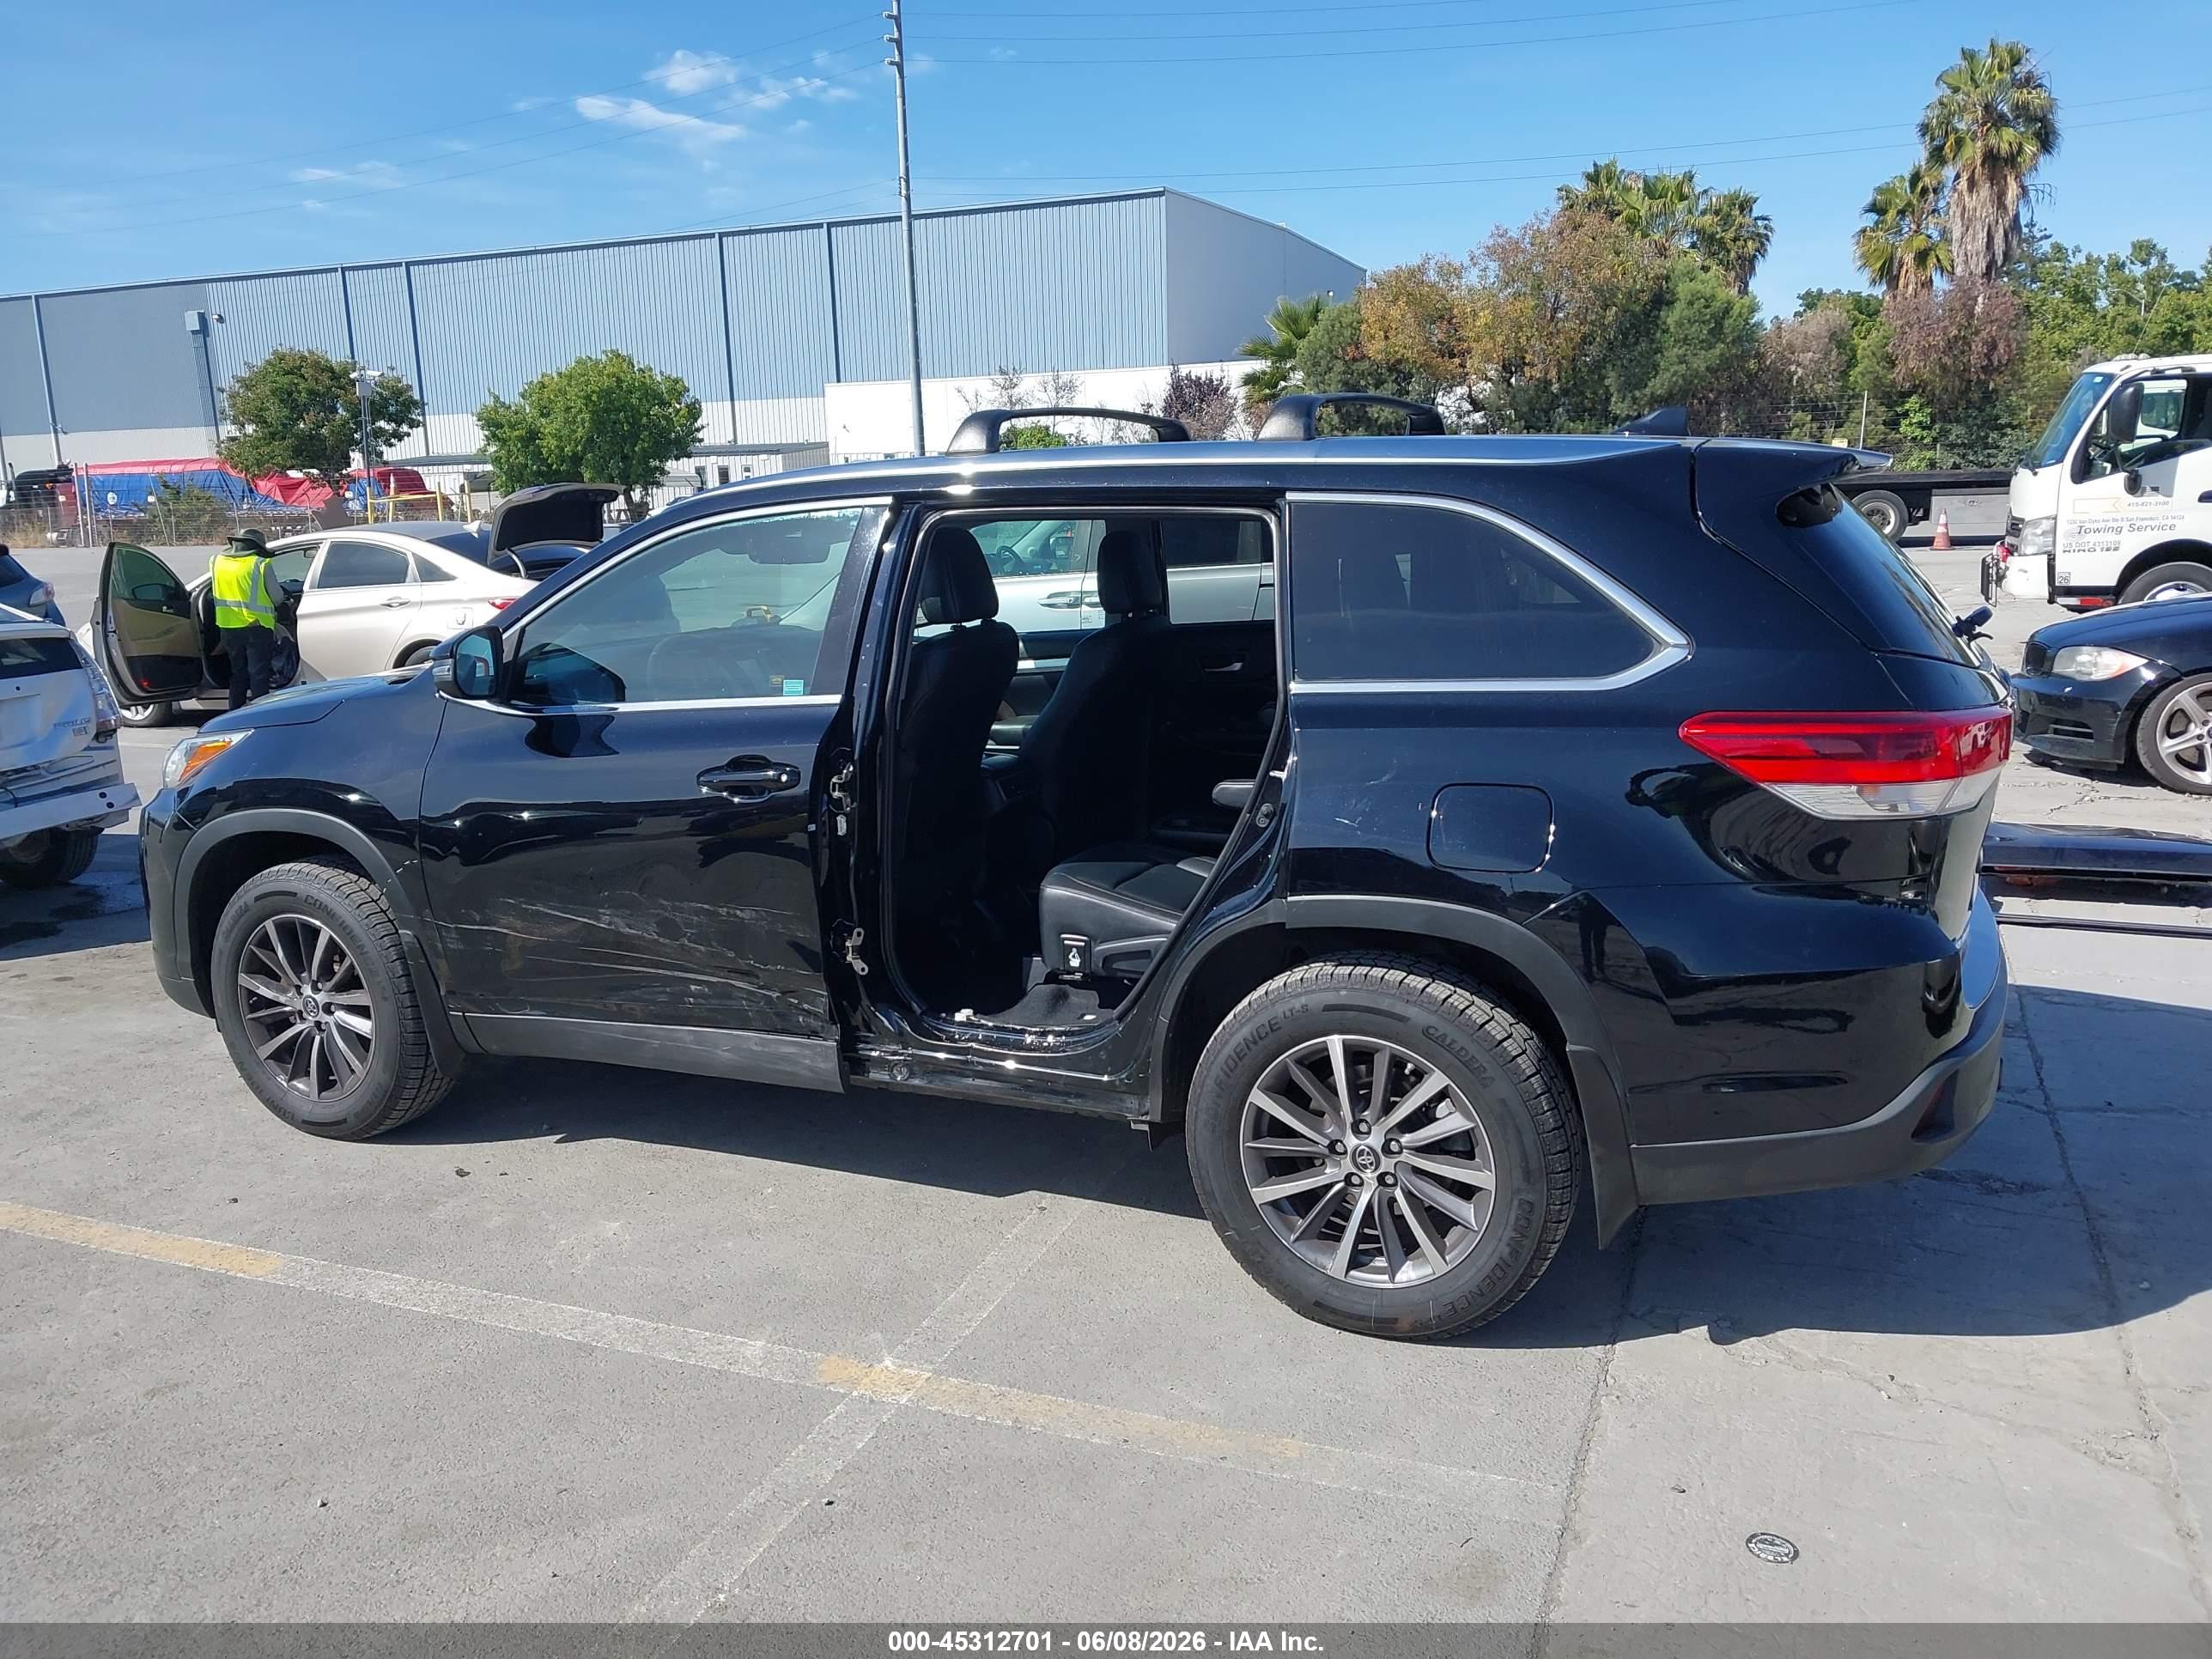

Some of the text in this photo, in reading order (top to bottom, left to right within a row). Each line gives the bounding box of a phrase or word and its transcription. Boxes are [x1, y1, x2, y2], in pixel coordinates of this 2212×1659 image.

[2077, 522, 2177, 535] Towing Service
[2058, 575, 2069, 584] 26
[1282, 1003, 1310, 1020] LT-S
[1423, 1025, 1496, 1089] CALDERA
[1443, 1198, 1534, 1317] CONFIDENCE
